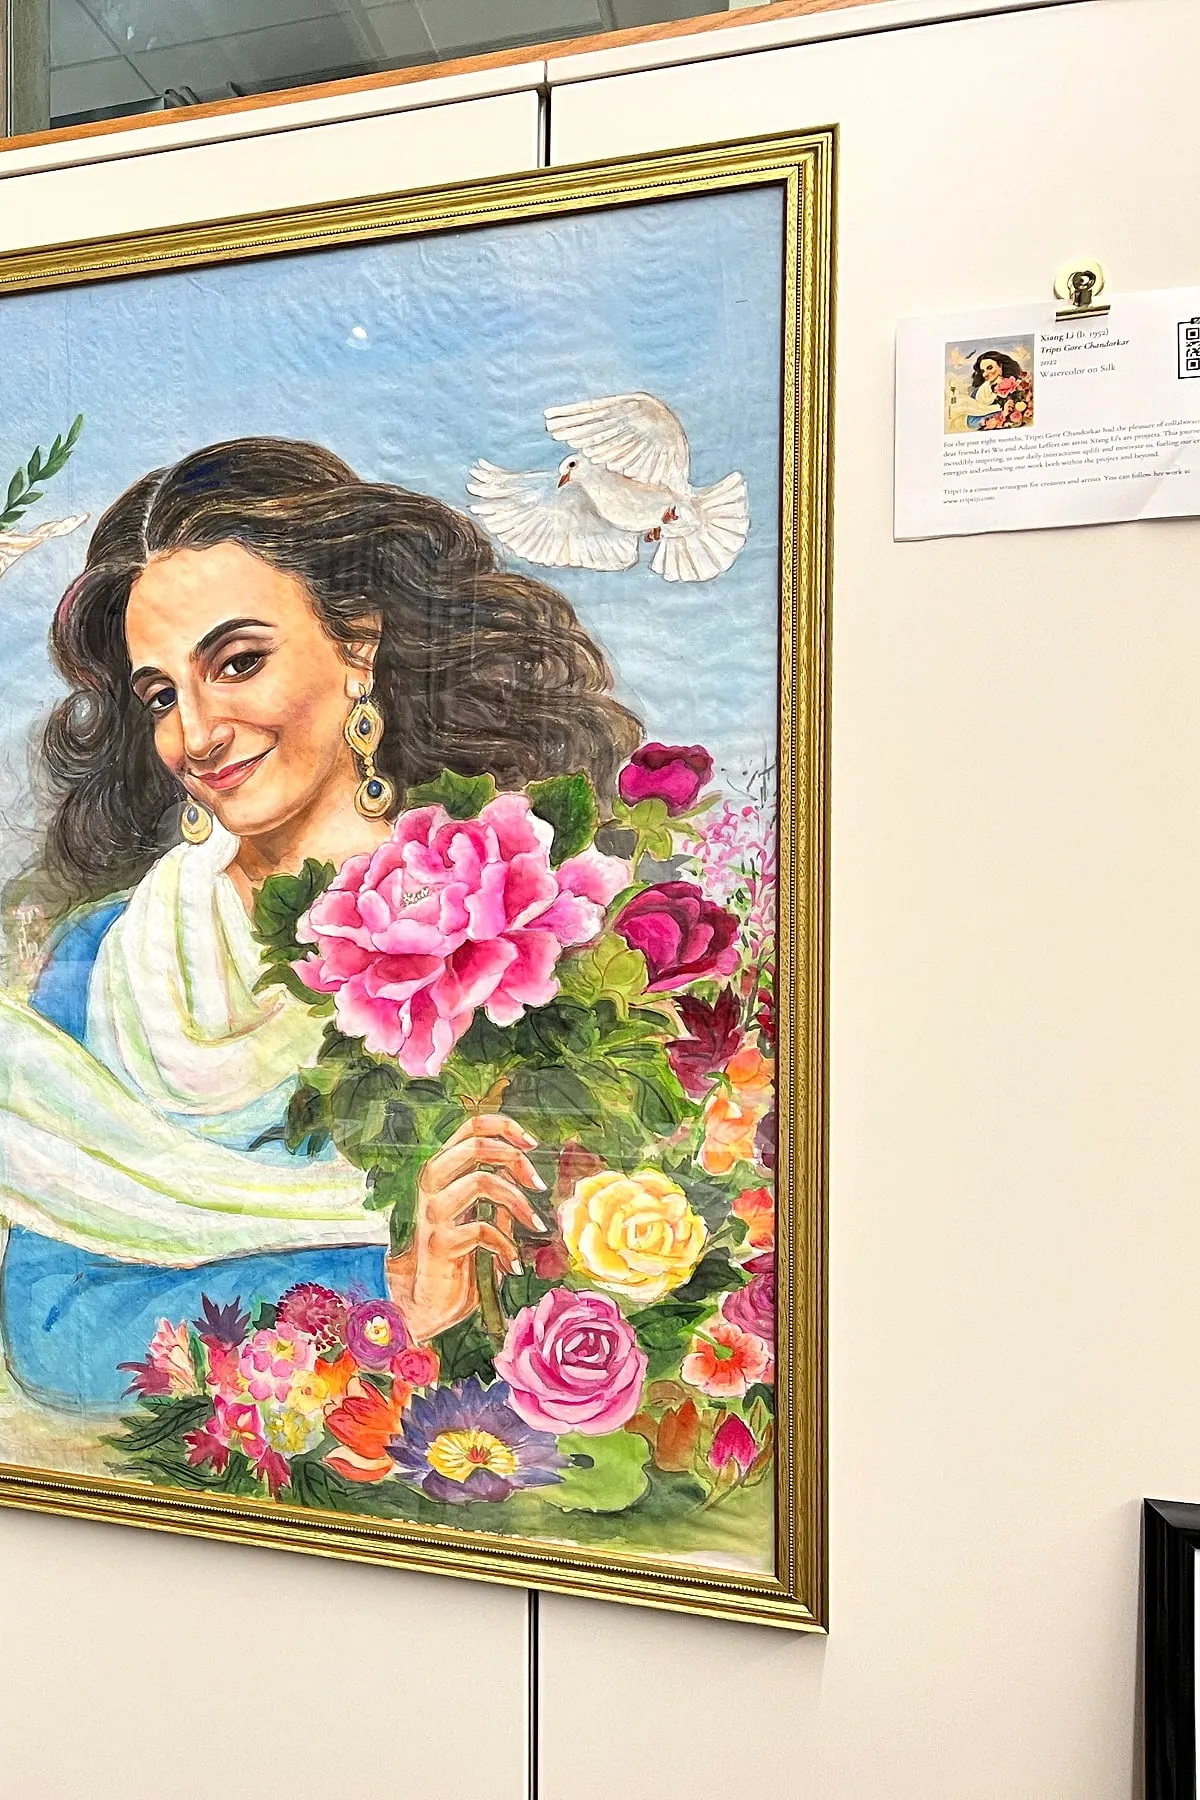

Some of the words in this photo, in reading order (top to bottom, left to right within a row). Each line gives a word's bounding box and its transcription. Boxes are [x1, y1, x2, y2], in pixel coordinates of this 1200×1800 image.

[1040, 333, 1063, 341] Xiang
[1066, 331, 1073, 339] Li
[1089, 328, 1108, 338] 1952)
[1040, 346, 1061, 355] Tripti
[1063, 343, 1081, 351] Gore
[1084, 338, 1129, 349] Chandorkar
[1039, 366, 1085, 377] Watercolor
[1100, 362, 1116, 371] Silk
